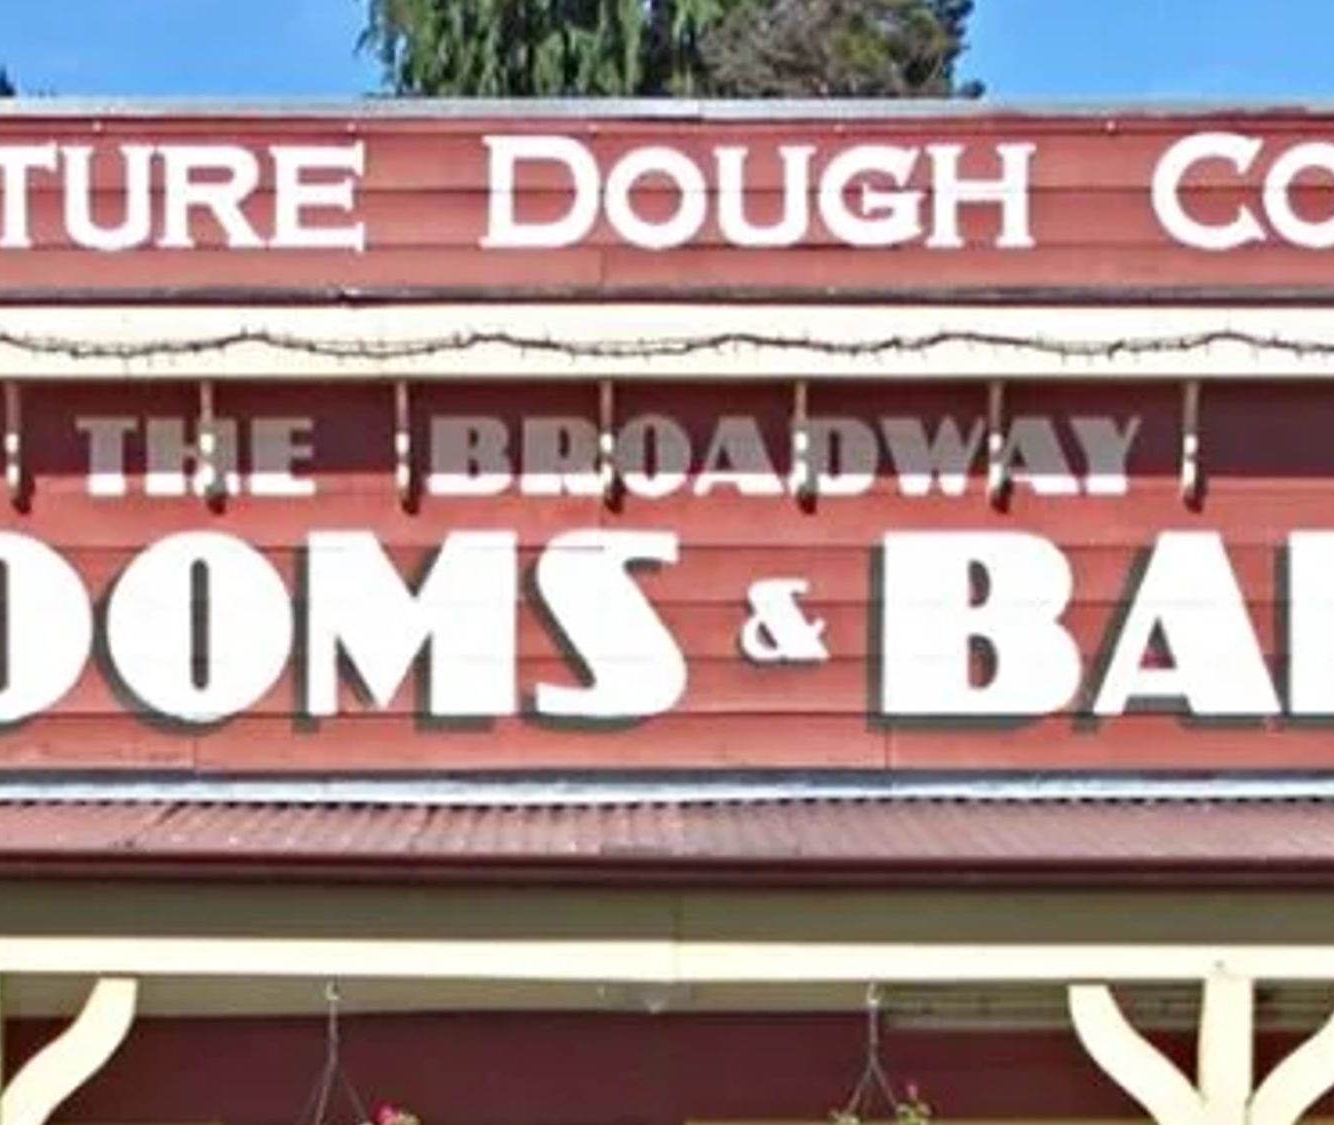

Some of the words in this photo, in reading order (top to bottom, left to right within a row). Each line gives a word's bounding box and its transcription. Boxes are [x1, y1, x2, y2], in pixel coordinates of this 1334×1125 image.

[479, 134, 1038, 251] DOUGH
[75, 415, 317, 498] THE
[425, 413, 1141, 498] BROADWAY
[739, 577, 830, 662] &
